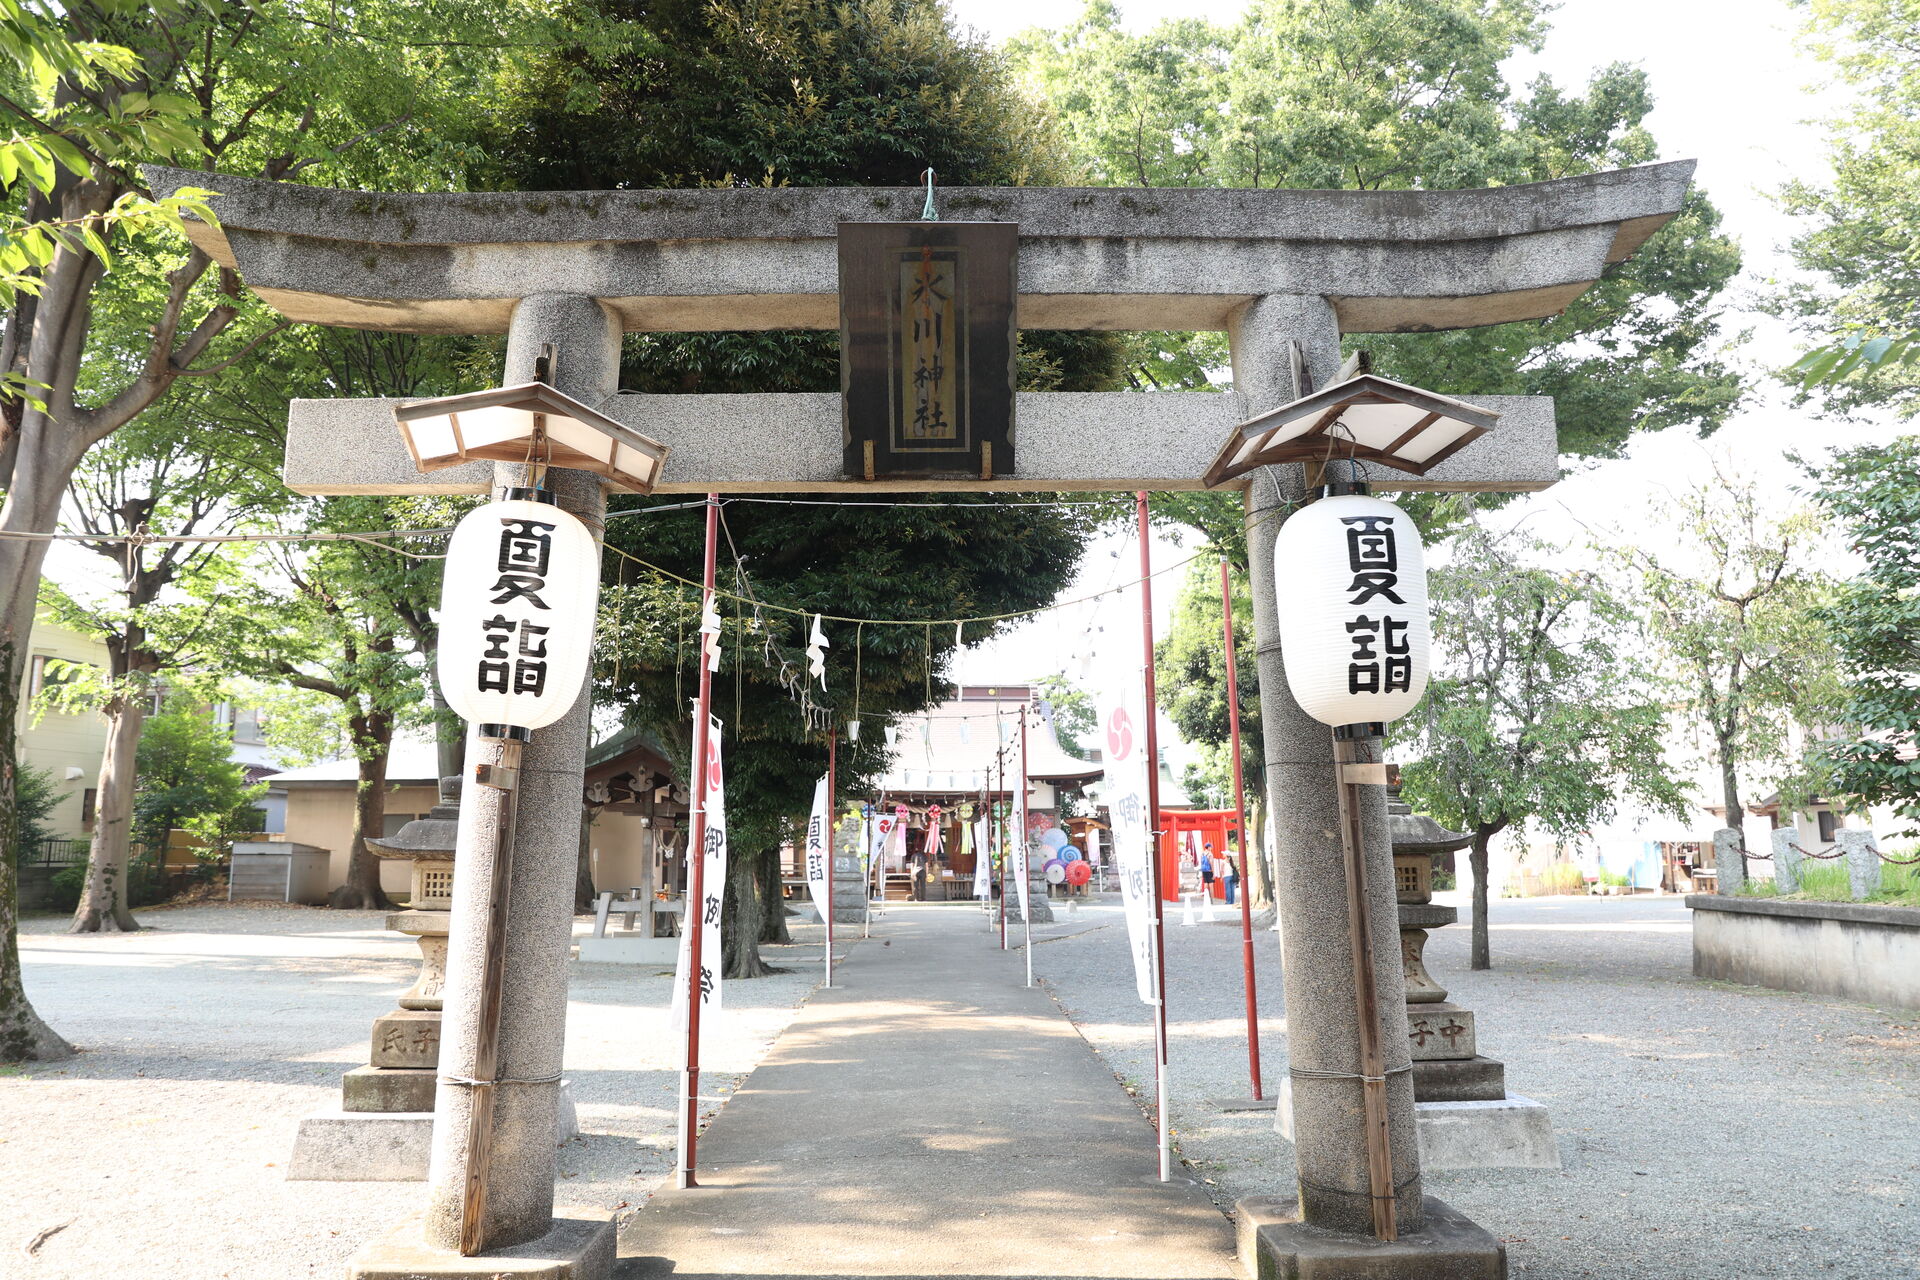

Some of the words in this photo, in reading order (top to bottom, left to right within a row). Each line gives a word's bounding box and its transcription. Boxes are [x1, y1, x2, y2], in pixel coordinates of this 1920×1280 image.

[911, 273, 947, 430] 氷川神社
[478, 518, 557, 697] 夏詣
[1338, 516, 1411, 695] 夏詣
[808, 815, 824, 882] 夏詣
[381, 1027, 440, 1054] 氏子
